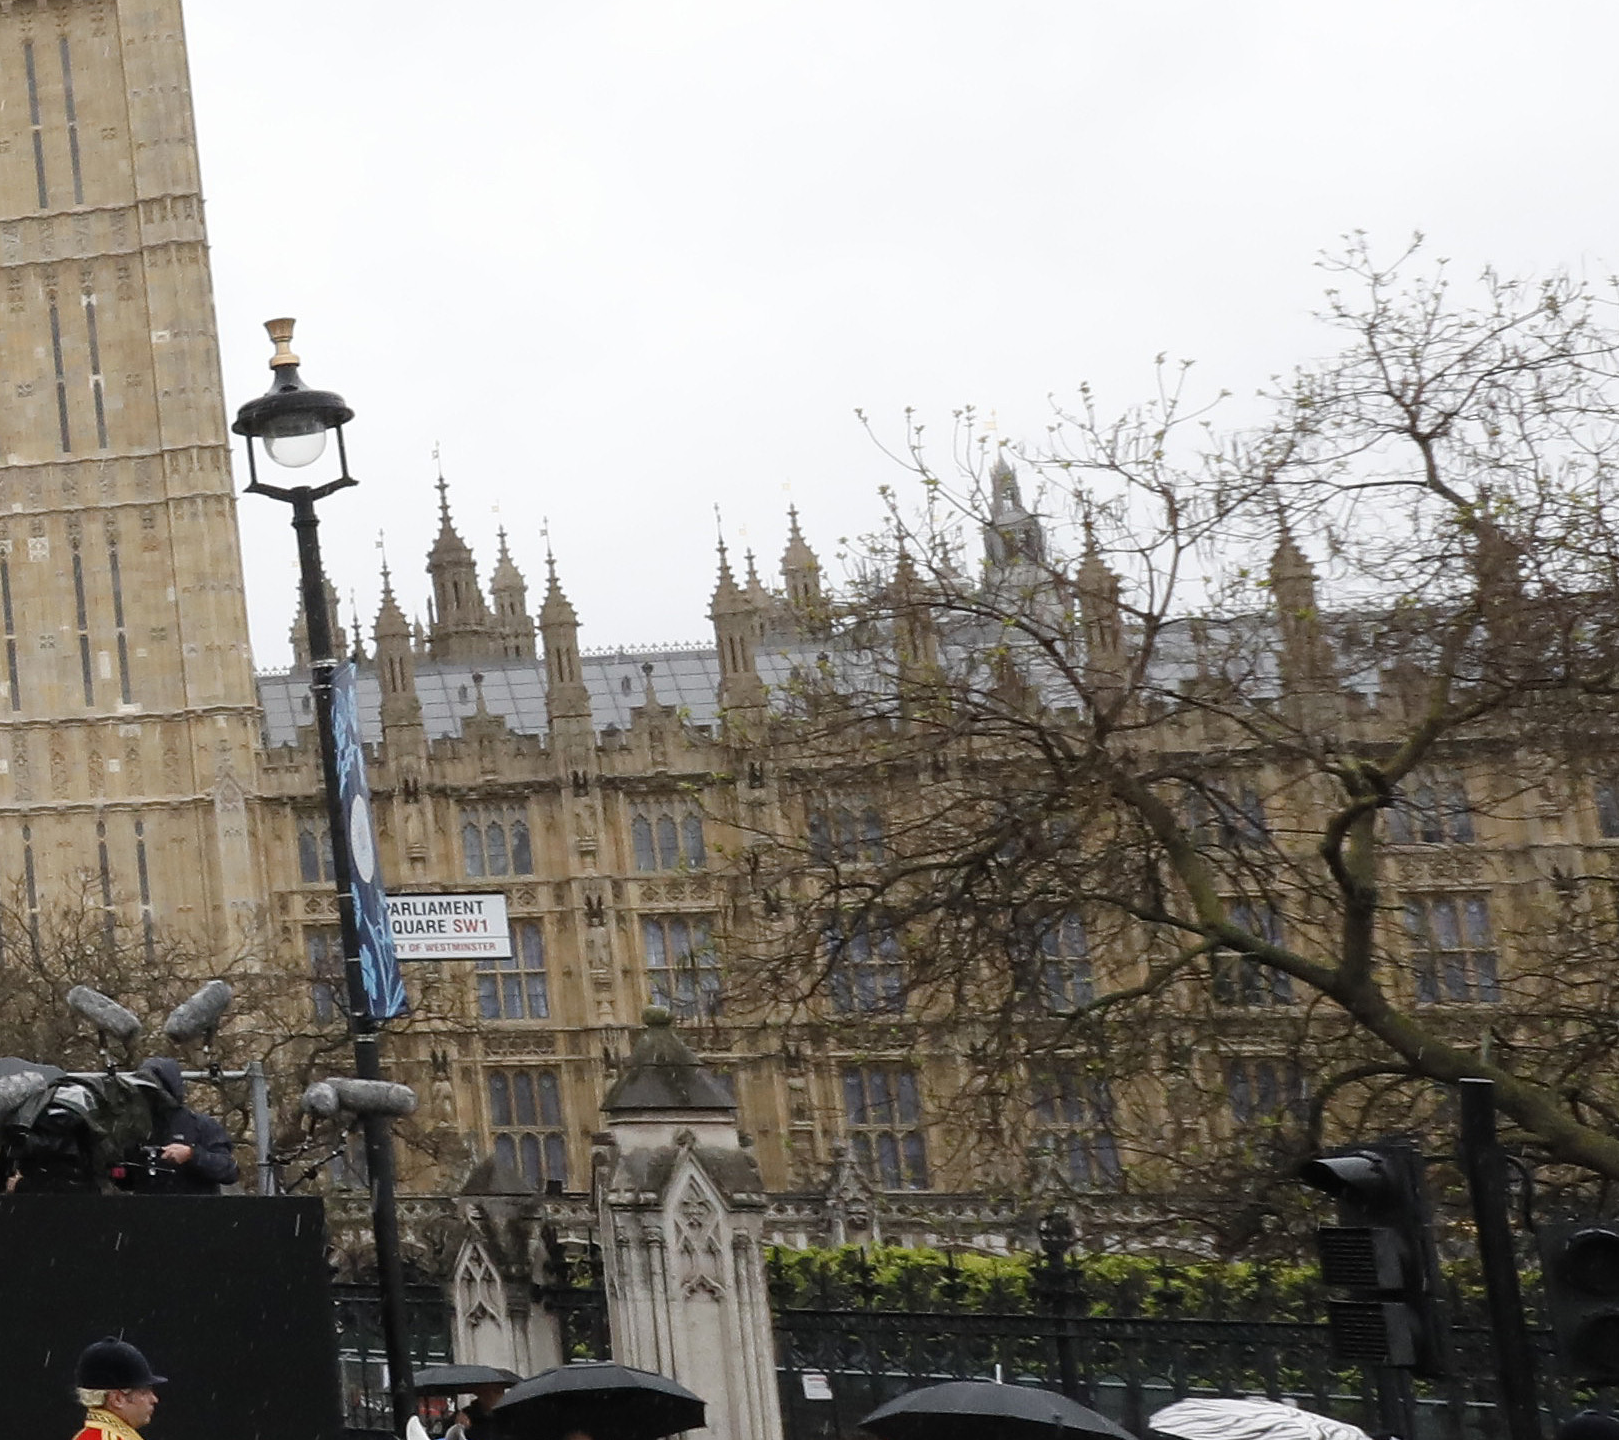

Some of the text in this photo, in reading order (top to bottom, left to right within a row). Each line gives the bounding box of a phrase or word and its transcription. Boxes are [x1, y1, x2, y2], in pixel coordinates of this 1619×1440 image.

[391, 918, 488, 934] QUARE SW1
[408, 943, 421, 953] OF
[425, 942, 497, 953] WESTMINSTER
